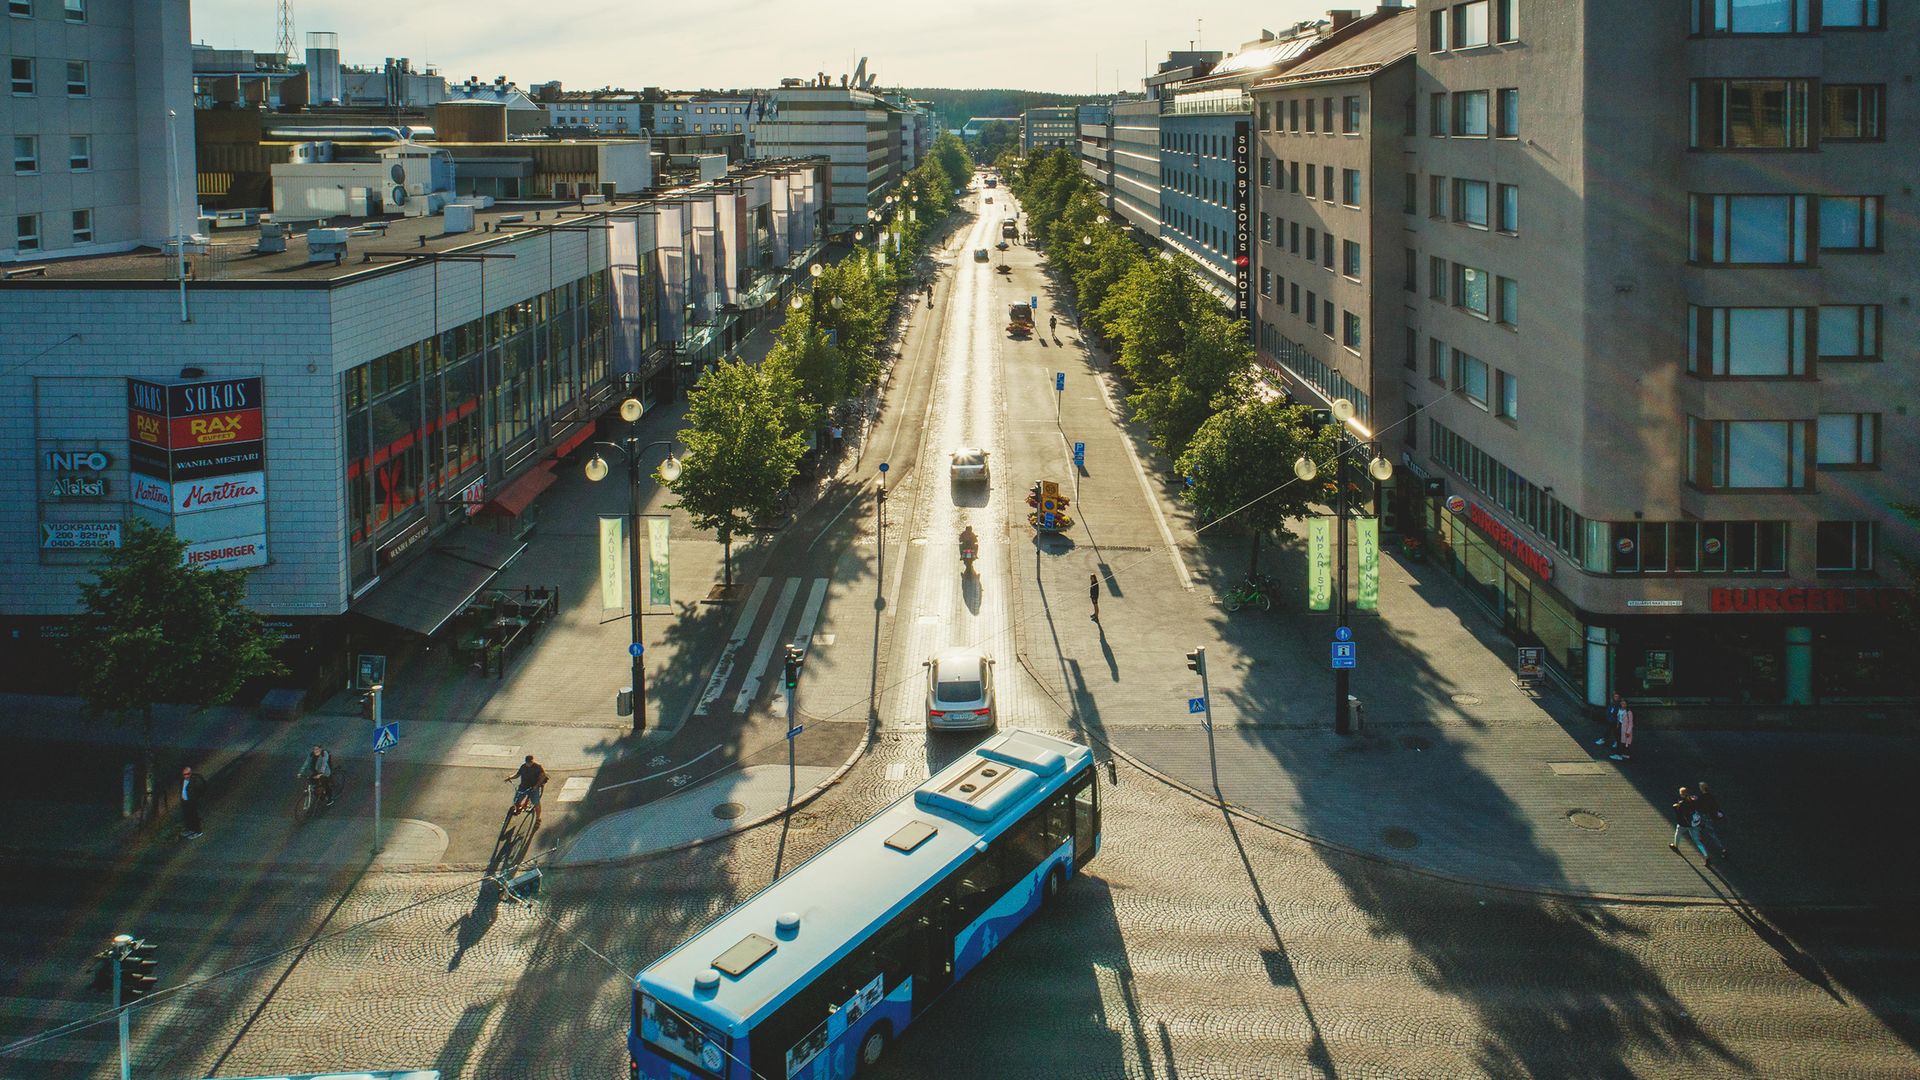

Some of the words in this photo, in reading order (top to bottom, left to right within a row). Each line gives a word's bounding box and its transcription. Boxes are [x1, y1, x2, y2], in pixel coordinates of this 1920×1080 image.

[1237, 135, 1247, 174] SOLO
[1237, 179, 1247, 198] BY
[1238, 203, 1248, 251] SOKOS
[133, 383, 161, 413] SOKOS
[185, 382, 246, 413] SOKOS
[137, 414, 160, 435] RAX
[191, 414, 242, 435] RAX
[46, 452, 108, 471] INFO
[176, 457, 213, 471] WANHA
[215, 452, 259, 466] MESTARI
[48, 478, 106, 497] Aleksi
[135, 479, 169, 505] Martina
[182, 481, 259, 508] Martina
[48, 523, 117, 531] VUOKRATAAN
[188, 544, 256, 564] HESBURGER
[1470, 502, 1515, 554] BURGER
[1516, 540, 1550, 583] KING
[1364, 530, 1374, 597] KAUPUNKI
[1711, 587, 1848, 613] BURGER
